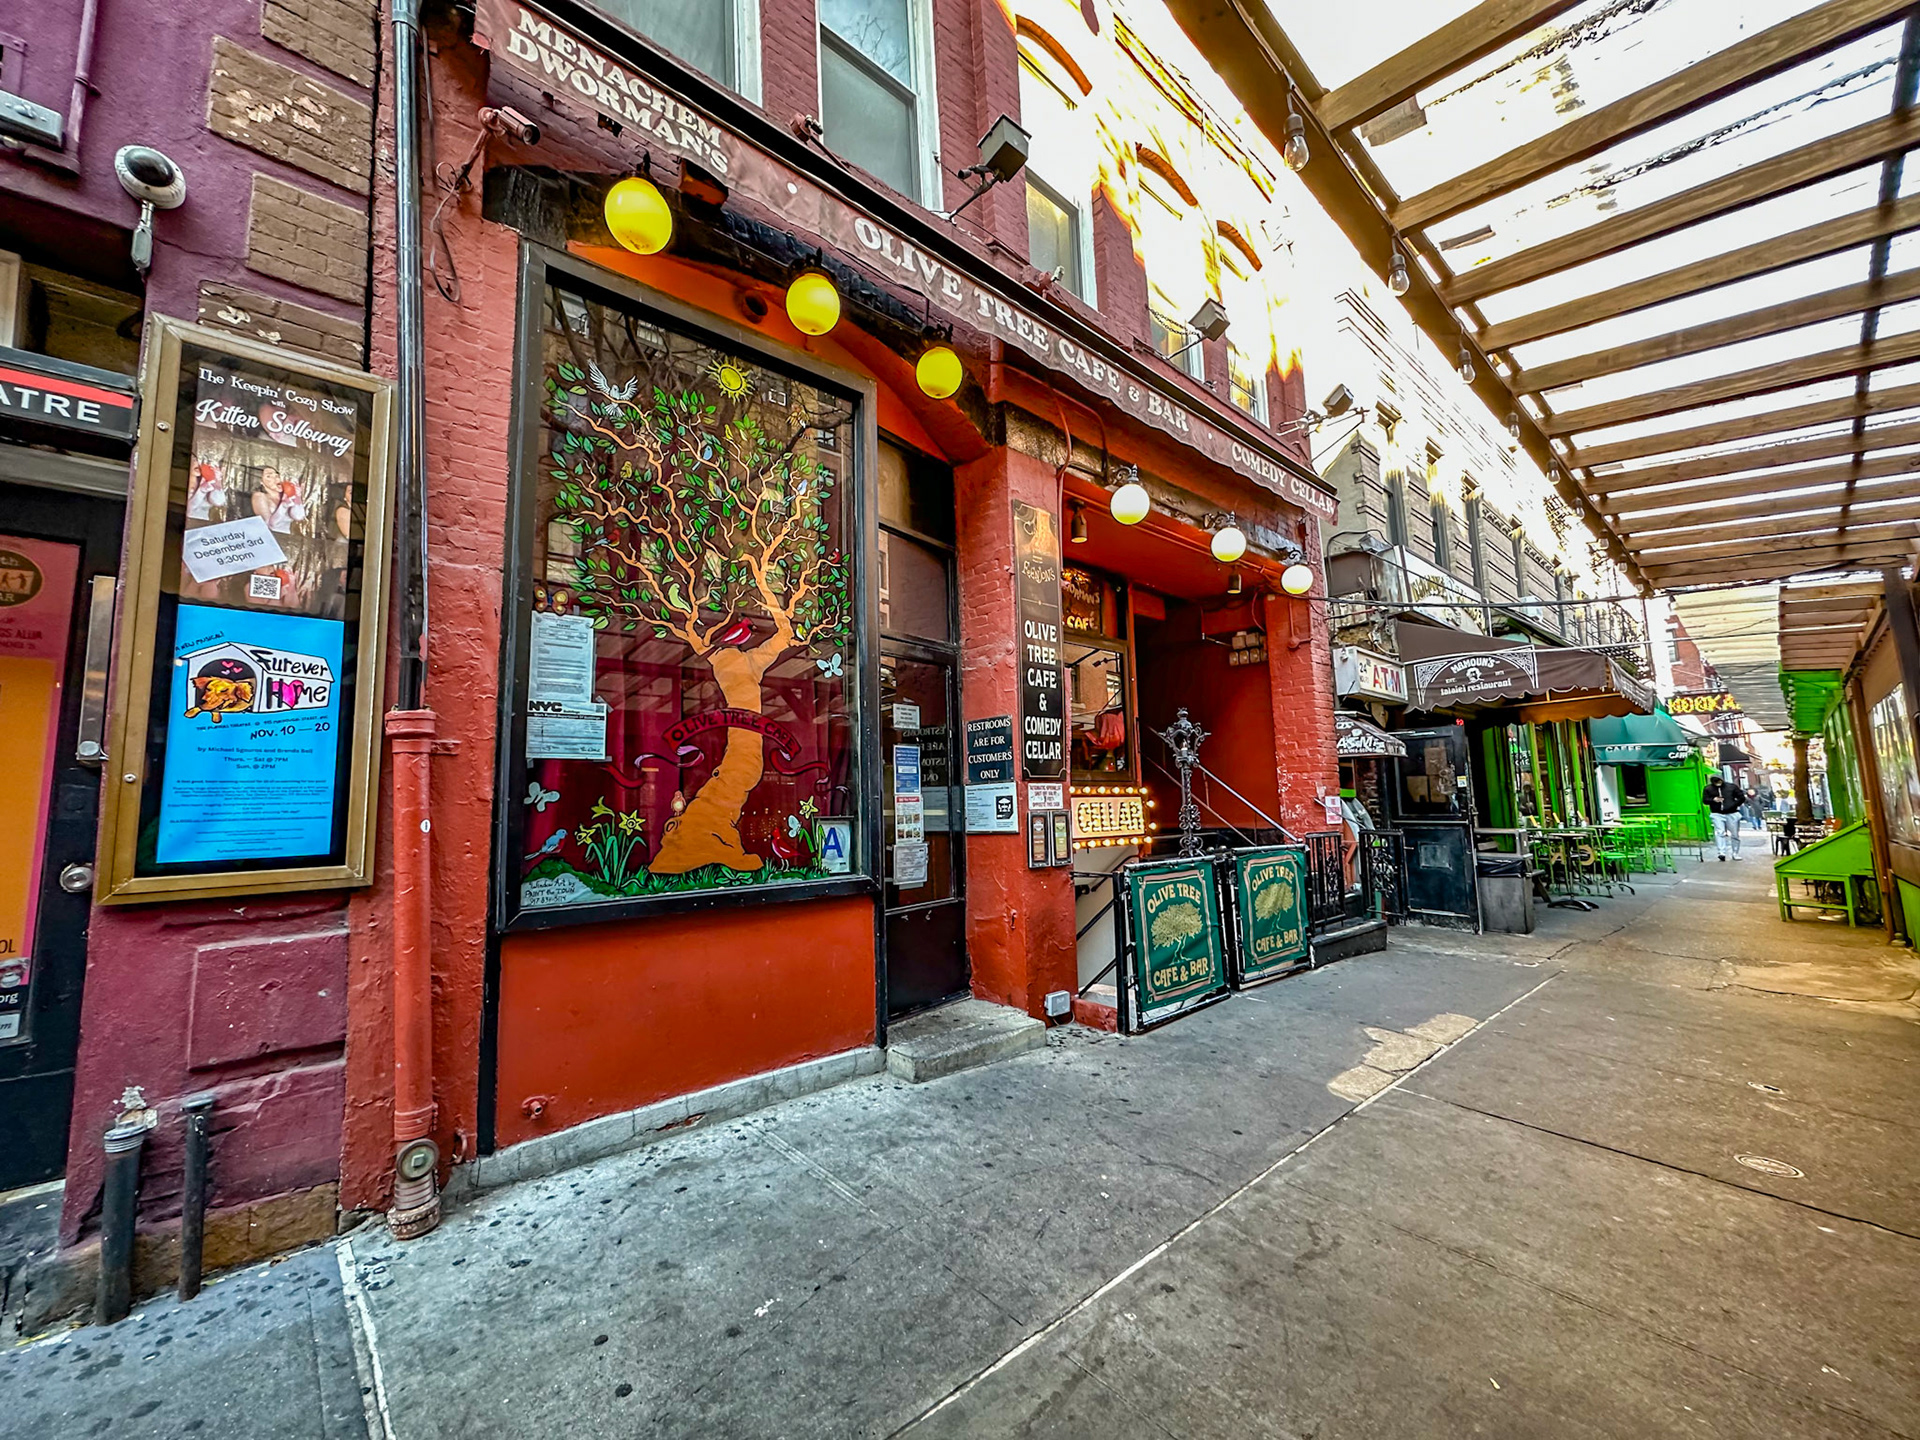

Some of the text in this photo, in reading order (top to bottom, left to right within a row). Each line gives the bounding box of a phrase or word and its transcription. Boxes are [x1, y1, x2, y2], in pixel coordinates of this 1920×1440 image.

[517, 8, 721, 148] MENACHEM
[507, 28, 728, 173] DWORMAN'S
[854, 218, 1336, 515] OLIVE TREE CAFE & BAR COMEDY CELLAR
[199, 367, 354, 415] The Keepin' Cozy Show
[195, 399, 352, 458] Kitten Solloway
[193, 537, 264, 559] December 3rd
[200, 531, 246, 547] Saturday
[1024, 620, 1057, 643] OLIVE
[249, 649, 328, 677] Furever
[1027, 644, 1057, 666] TREE
[1450, 657, 1496, 674] MAMOUN'S
[1027, 668, 1057, 689] CAFE
[1373, 664, 1401, 693] ATM
[1467, 678, 1512, 691] restaurant
[530, 701, 562, 712] NYC
[1039, 693, 1047, 712] &
[250, 729, 278, 740] NOV.
[280, 725, 296, 736] 10
[315, 721, 331, 732] 20
[672, 713, 718, 742] OLIVE
[722, 710, 759, 728] TREE
[968, 719, 1011, 733] RESTROOMS
[1025, 716, 1061, 736] COMEDY
[973, 736, 1005, 748] ARE FOR
[1025, 740, 1061, 760] CELLAR
[969, 751, 1012, 764] CUSTOMERS
[980, 769, 1000, 780] ONLY
[1077, 802, 1145, 833] CELLAR
[822, 827, 844, 858] A
[1252, 866, 1294, 891] OLIVE TREE
[1147, 883, 1201, 914] OLIVE TREE
[1256, 929, 1298, 953] CAFE & BAR
[1153, 957, 1208, 987] CAFE & BAR
